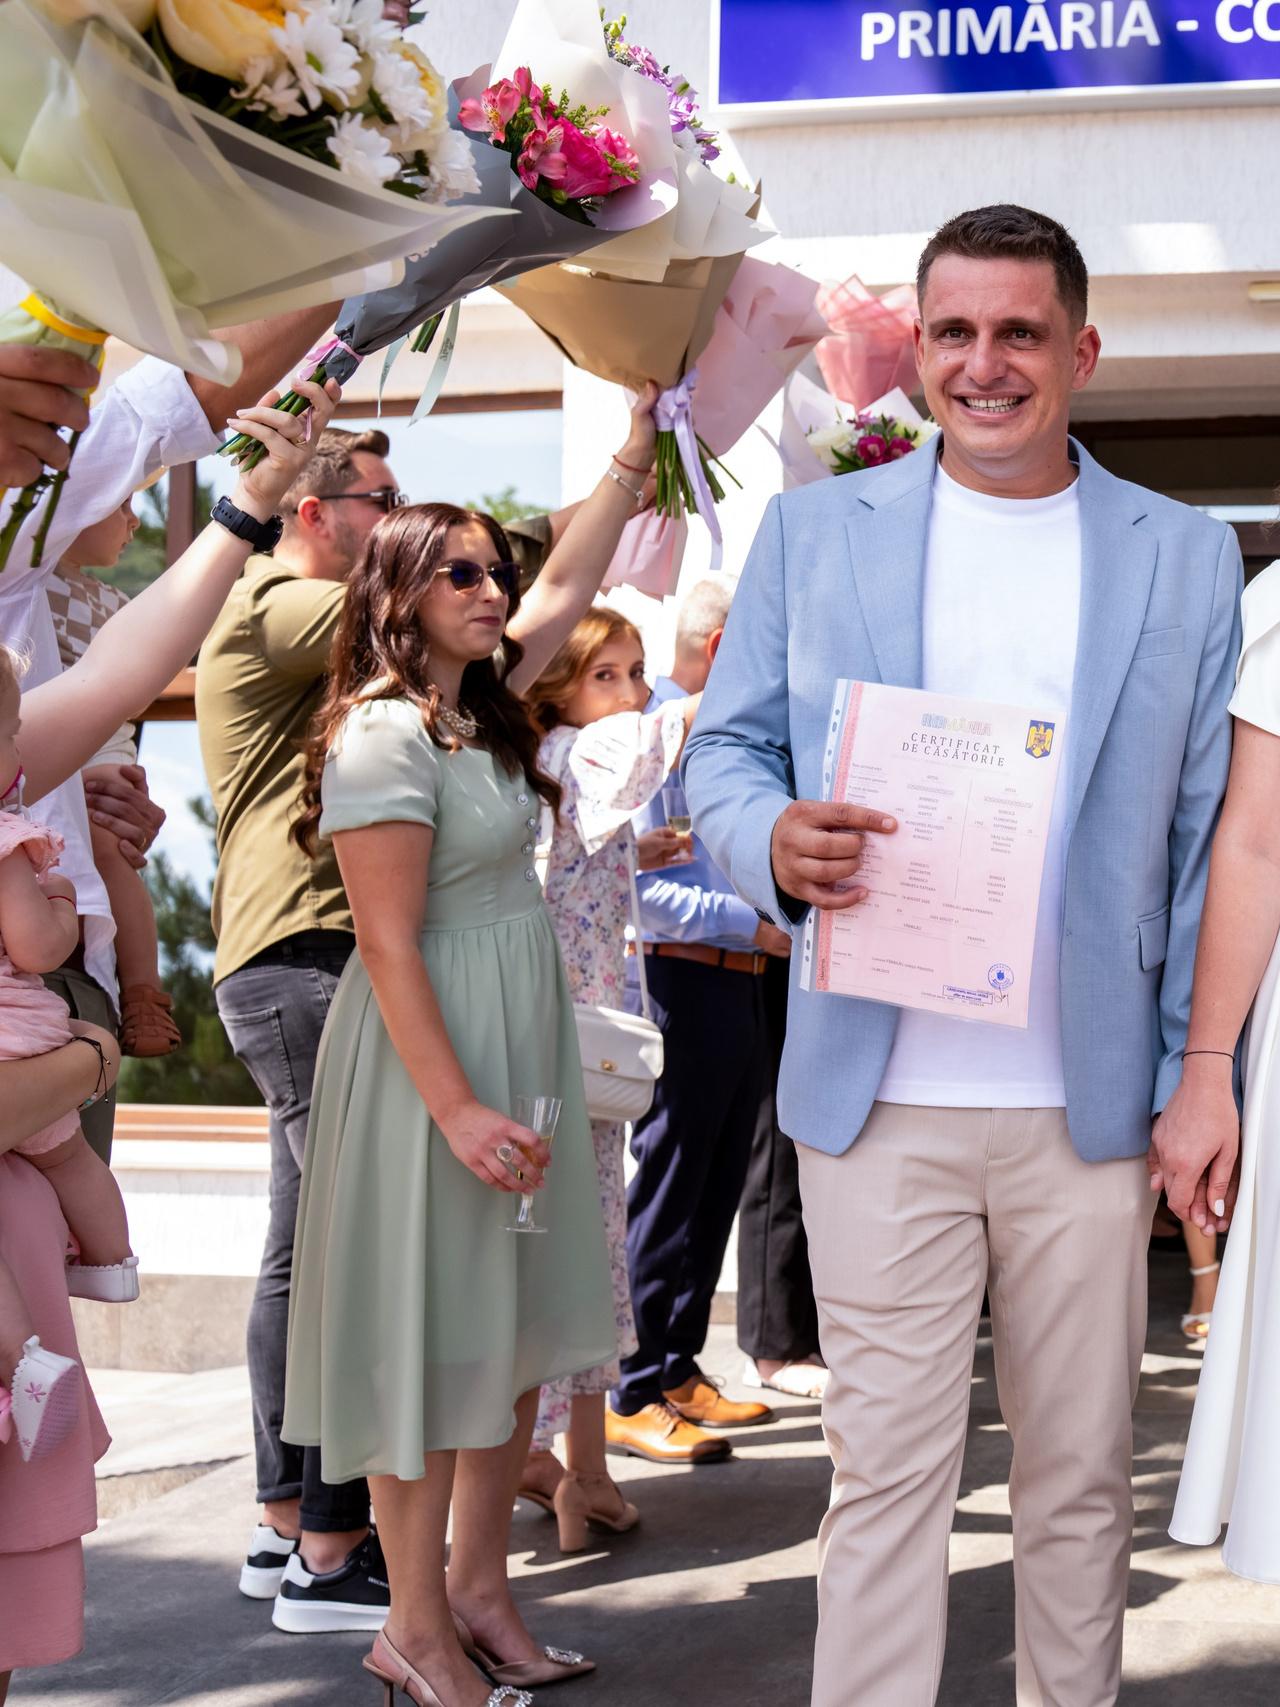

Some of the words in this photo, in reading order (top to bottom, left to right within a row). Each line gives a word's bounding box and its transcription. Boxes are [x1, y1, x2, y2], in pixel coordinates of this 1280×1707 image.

[921, 714, 991, 736] ROMÂNIA
[902, 742, 918, 753] DE
[924, 746, 1004, 767] CĂSĂTORIE
[911, 733, 1000, 754] CERTIFICAT
